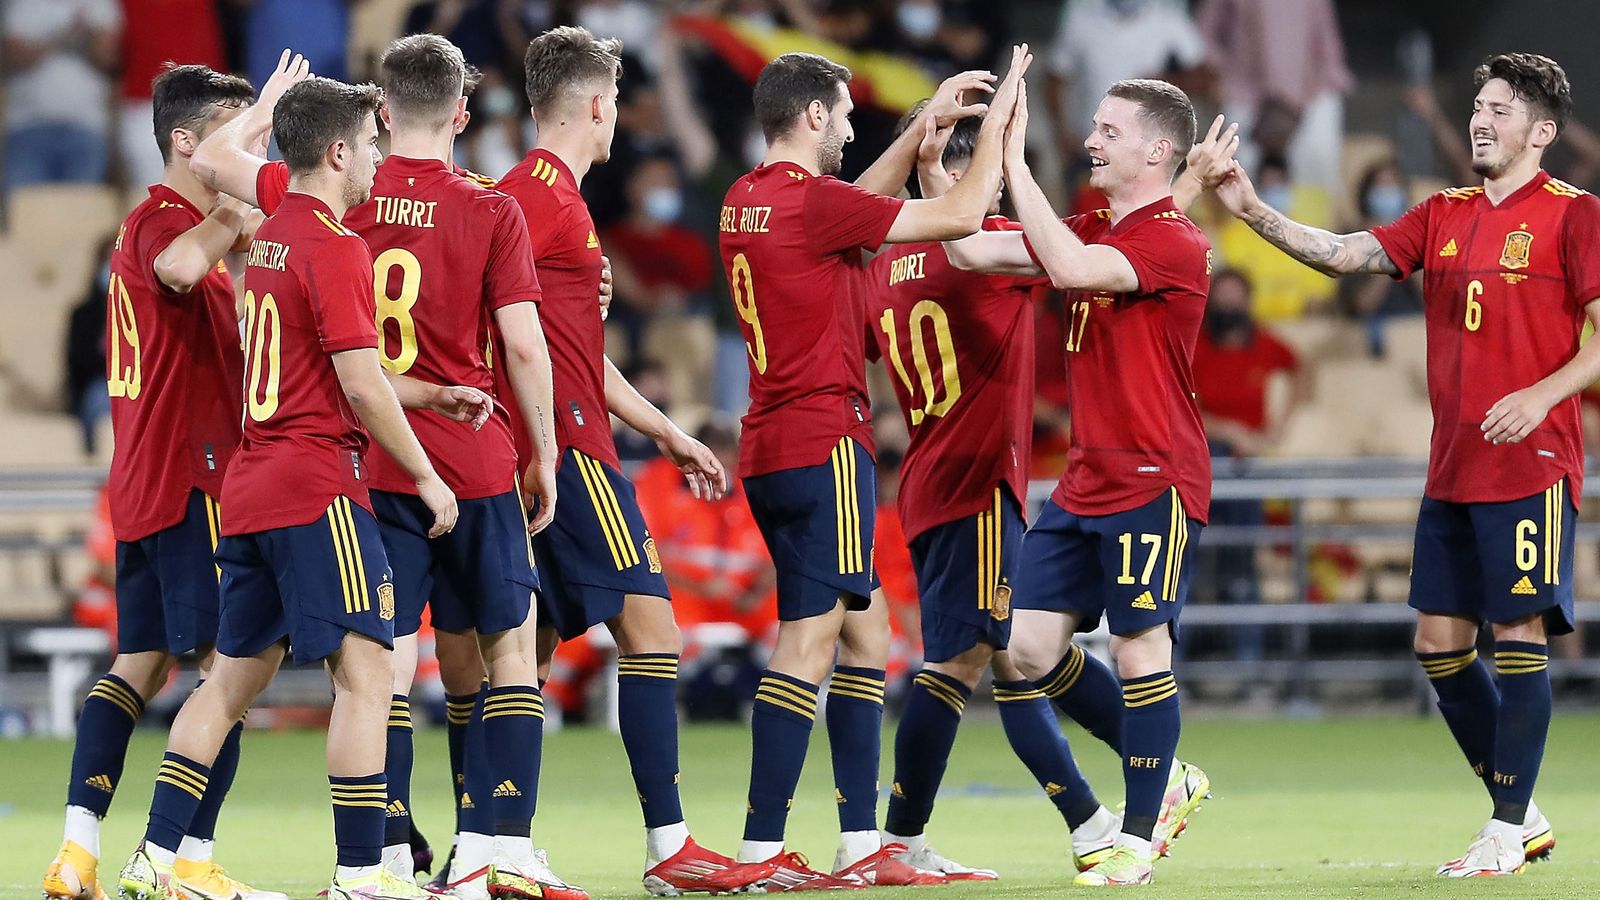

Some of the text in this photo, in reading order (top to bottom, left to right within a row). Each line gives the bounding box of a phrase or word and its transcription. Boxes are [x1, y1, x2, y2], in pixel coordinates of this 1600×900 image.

[374, 196, 438, 228] TURRI
[740, 206, 772, 233] RUIZ
[889, 252, 927, 286] RODRI
[373, 247, 422, 375] 8
[732, 252, 767, 375] 9
[1066, 301, 1089, 352] 17
[1464, 279, 1483, 331] 6
[107, 272, 142, 400] 19
[880, 299, 962, 426] 10
[1117, 532, 1162, 586] 17
[1515, 518, 1538, 571] 6
[1129, 756, 1160, 769] RFEF
